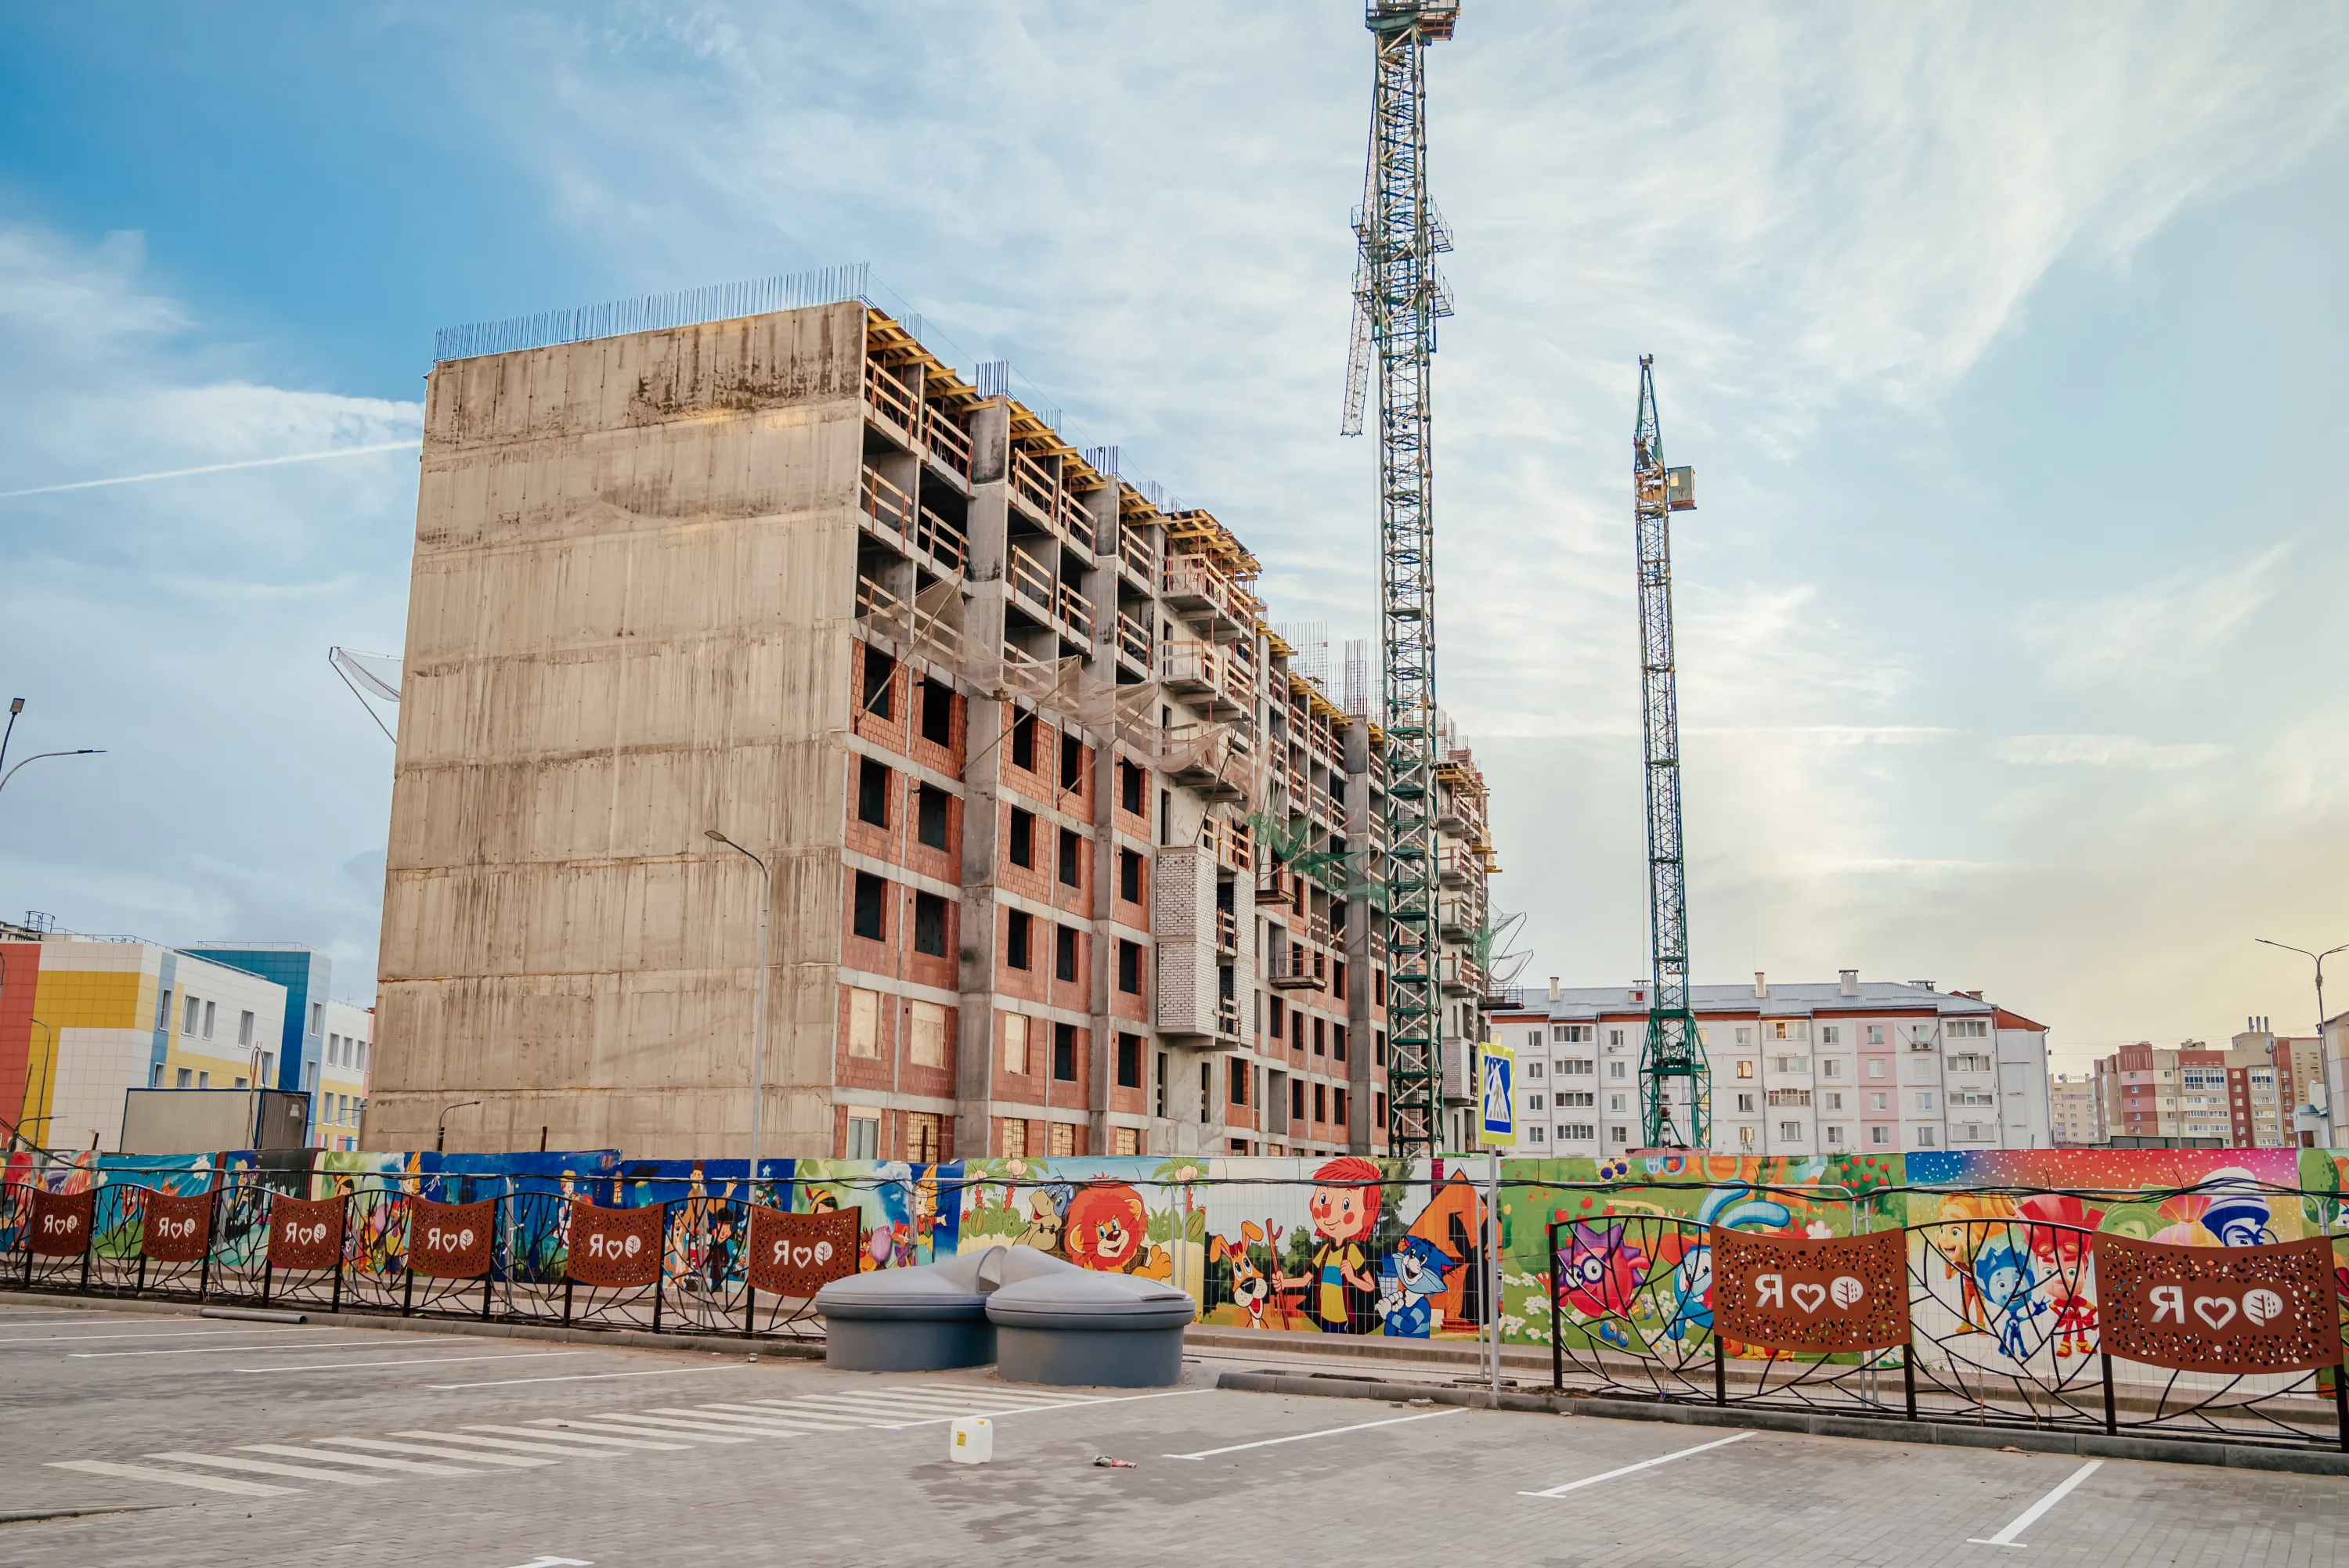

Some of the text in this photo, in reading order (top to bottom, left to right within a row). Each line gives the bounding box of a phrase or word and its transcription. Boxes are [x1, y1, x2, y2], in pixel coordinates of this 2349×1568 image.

[43, 1214, 54, 1234] Я
[157, 1217, 170, 1237] Я
[284, 1222, 298, 1243] Я
[427, 1227, 441, 1250] Я
[589, 1233, 604, 1257] Я
[773, 1240, 789, 1266] Я
[1755, 1274, 1784, 1308] Я
[2149, 1285, 2185, 1324] Я
